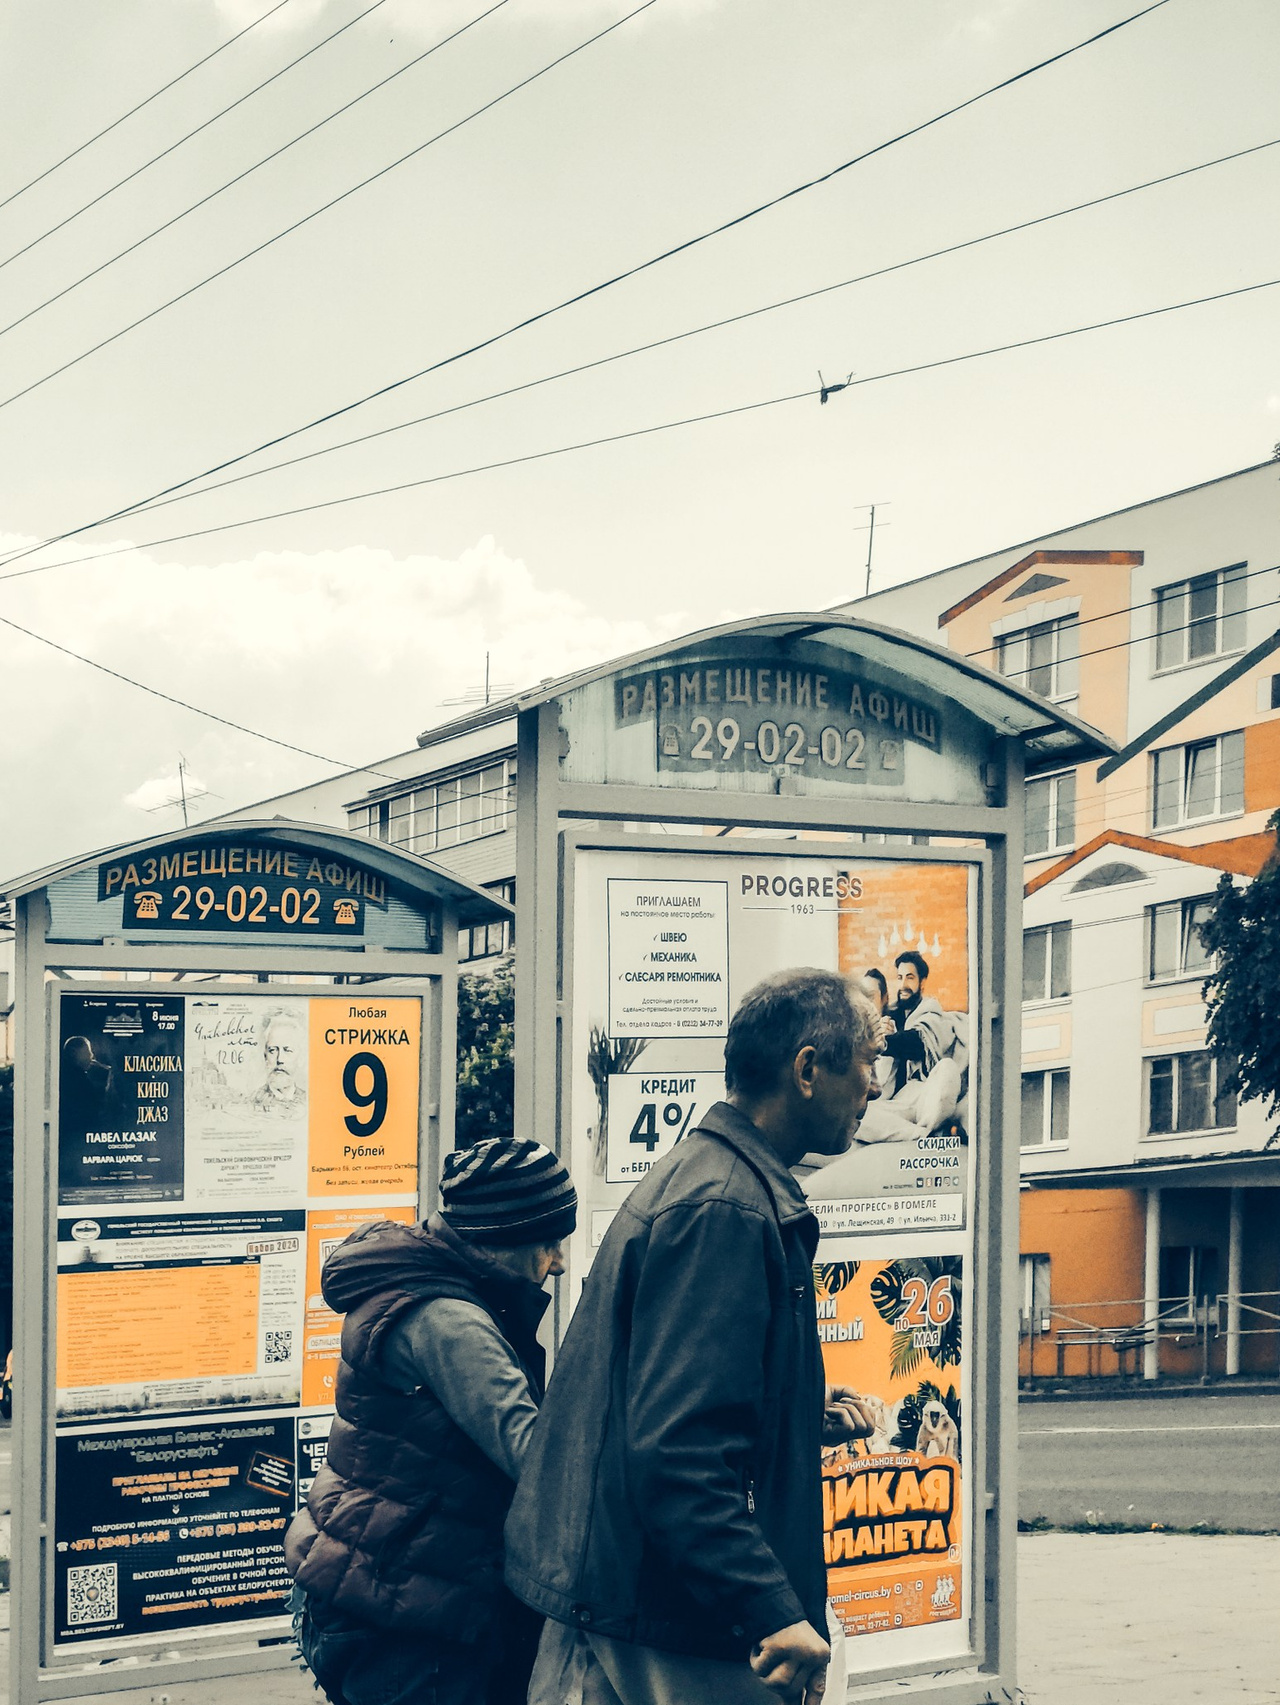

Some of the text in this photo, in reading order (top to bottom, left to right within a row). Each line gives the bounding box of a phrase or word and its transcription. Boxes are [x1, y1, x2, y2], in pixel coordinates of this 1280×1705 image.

[622, 667, 936, 744] РАЗМЕЩЕНИЕ АФИШ
[690, 716, 866, 770] 29-02-02
[105, 847, 386, 904] РАЗМЕЩЕНИЕ АФИШ
[742, 874, 862, 898] PROGRESS
[171, 885, 320, 924] 29-02-02
[636, 895, 701, 907] ПРИГЛАШАЕМ
[790, 904, 814, 914] 1963
[660, 932, 687, 943] ШВЕЮ
[650, 952, 697, 962] МЕХАНИКА
[625, 972, 721, 982] СЛЕСАРЯ РЕМОНТНИКА
[152, 1011, 158, 1021] 8
[348, 1007, 387, 1018] Любая
[325, 1028, 410, 1045] СТРИЖКА
[124, 1055, 183, 1072] КЛАССИКА
[137, 1081, 169, 1099] КИНО
[342, 1051, 389, 1137] 9
[641, 1079, 696, 1096] КРЕДИТ
[136, 1106, 169, 1125] ДЖАЗ
[85, 1131, 157, 1143] ПАВЕЛ КАЗАК
[917, 1137, 960, 1151] СКИДКИ
[343, 1145, 385, 1159] Рублей
[899, 1156, 959, 1169] РАССРОЧКА
[901, 1199, 937, 1210] ГОМЕЛЕ
[276, 1239, 297, 1251] 2024
[901, 1275, 954, 1327] 26
[913, 1330, 941, 1348] МАЯ
[77, 1425, 275, 1453] Международная Бизнес-Академия
[844, 1455, 913, 1473] УНИКАЛЬНОЕ ШОУ
[142, 1490, 210, 1504] НА ПЛАТНОЙ ОСНОВЕ
[92, 1506, 280, 1533] ПОДРОБНУЮ ИНФОРМАЦИЮ УТОЧНЯЙТЕ ПО ТЕЛЕФОНАМ
[176, 1551, 221, 1564] ПЕРЕДОВЫЕ
[222, 1547, 254, 1561] МЕТОДЫ
[132, 1557, 255, 1581] ВЫСОКОКВАЛИФИЦИРОВАННЫЙ
[191, 1573, 231, 1585] ОБУЧЕНИЕ
[232, 1572, 238, 1580] В
[239, 1567, 267, 1580] ОЧНОЙ
[145, 1578, 295, 1603] ПРАКТИКА НА ОБЪЕКТАХ БЕЛОРУСНЕФТИ
[826, 1586, 892, 1605] gomel-circus.by
